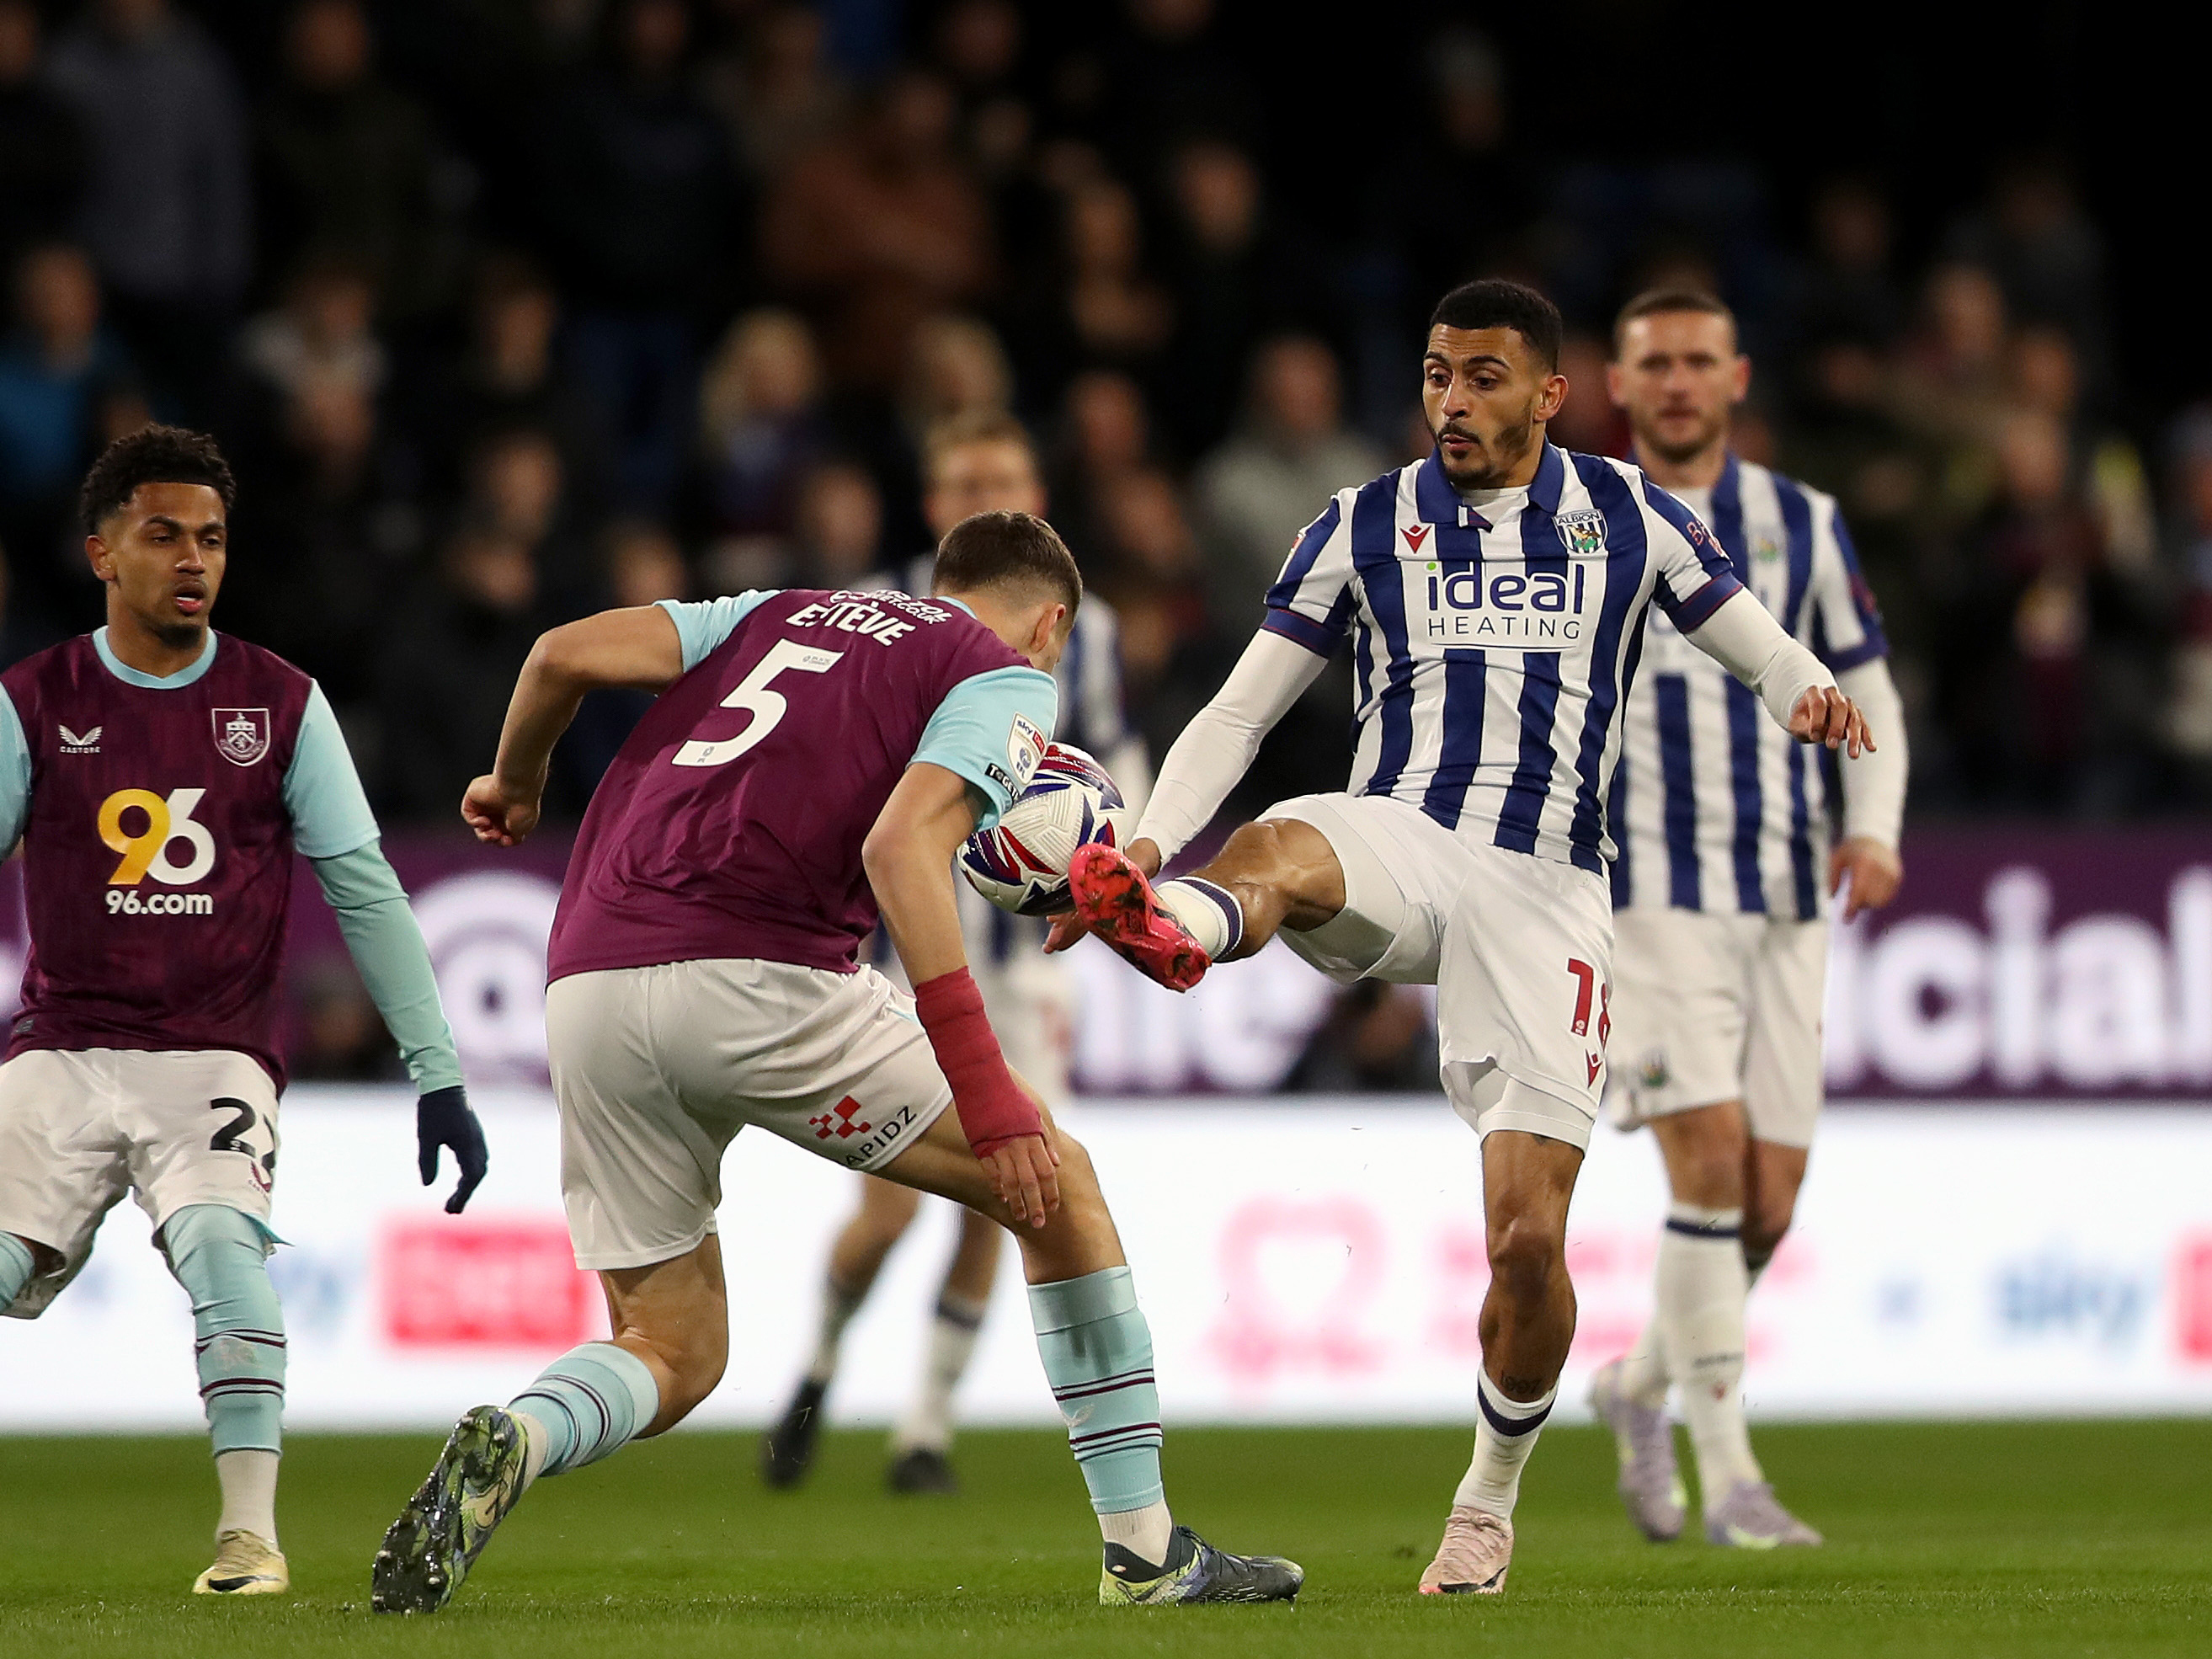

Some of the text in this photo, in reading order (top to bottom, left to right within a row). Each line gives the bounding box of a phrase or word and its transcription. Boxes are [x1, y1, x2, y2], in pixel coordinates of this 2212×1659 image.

[1558, 512, 1600, 525] ALBION
[1426, 562, 1584, 614] ideal
[1428, 616, 1580, 639] HEATING
[671, 637, 845, 767] 5
[59, 745, 102, 755] CASTORE
[97, 787, 216, 886] 96
[104, 889, 214, 915] 96.com
